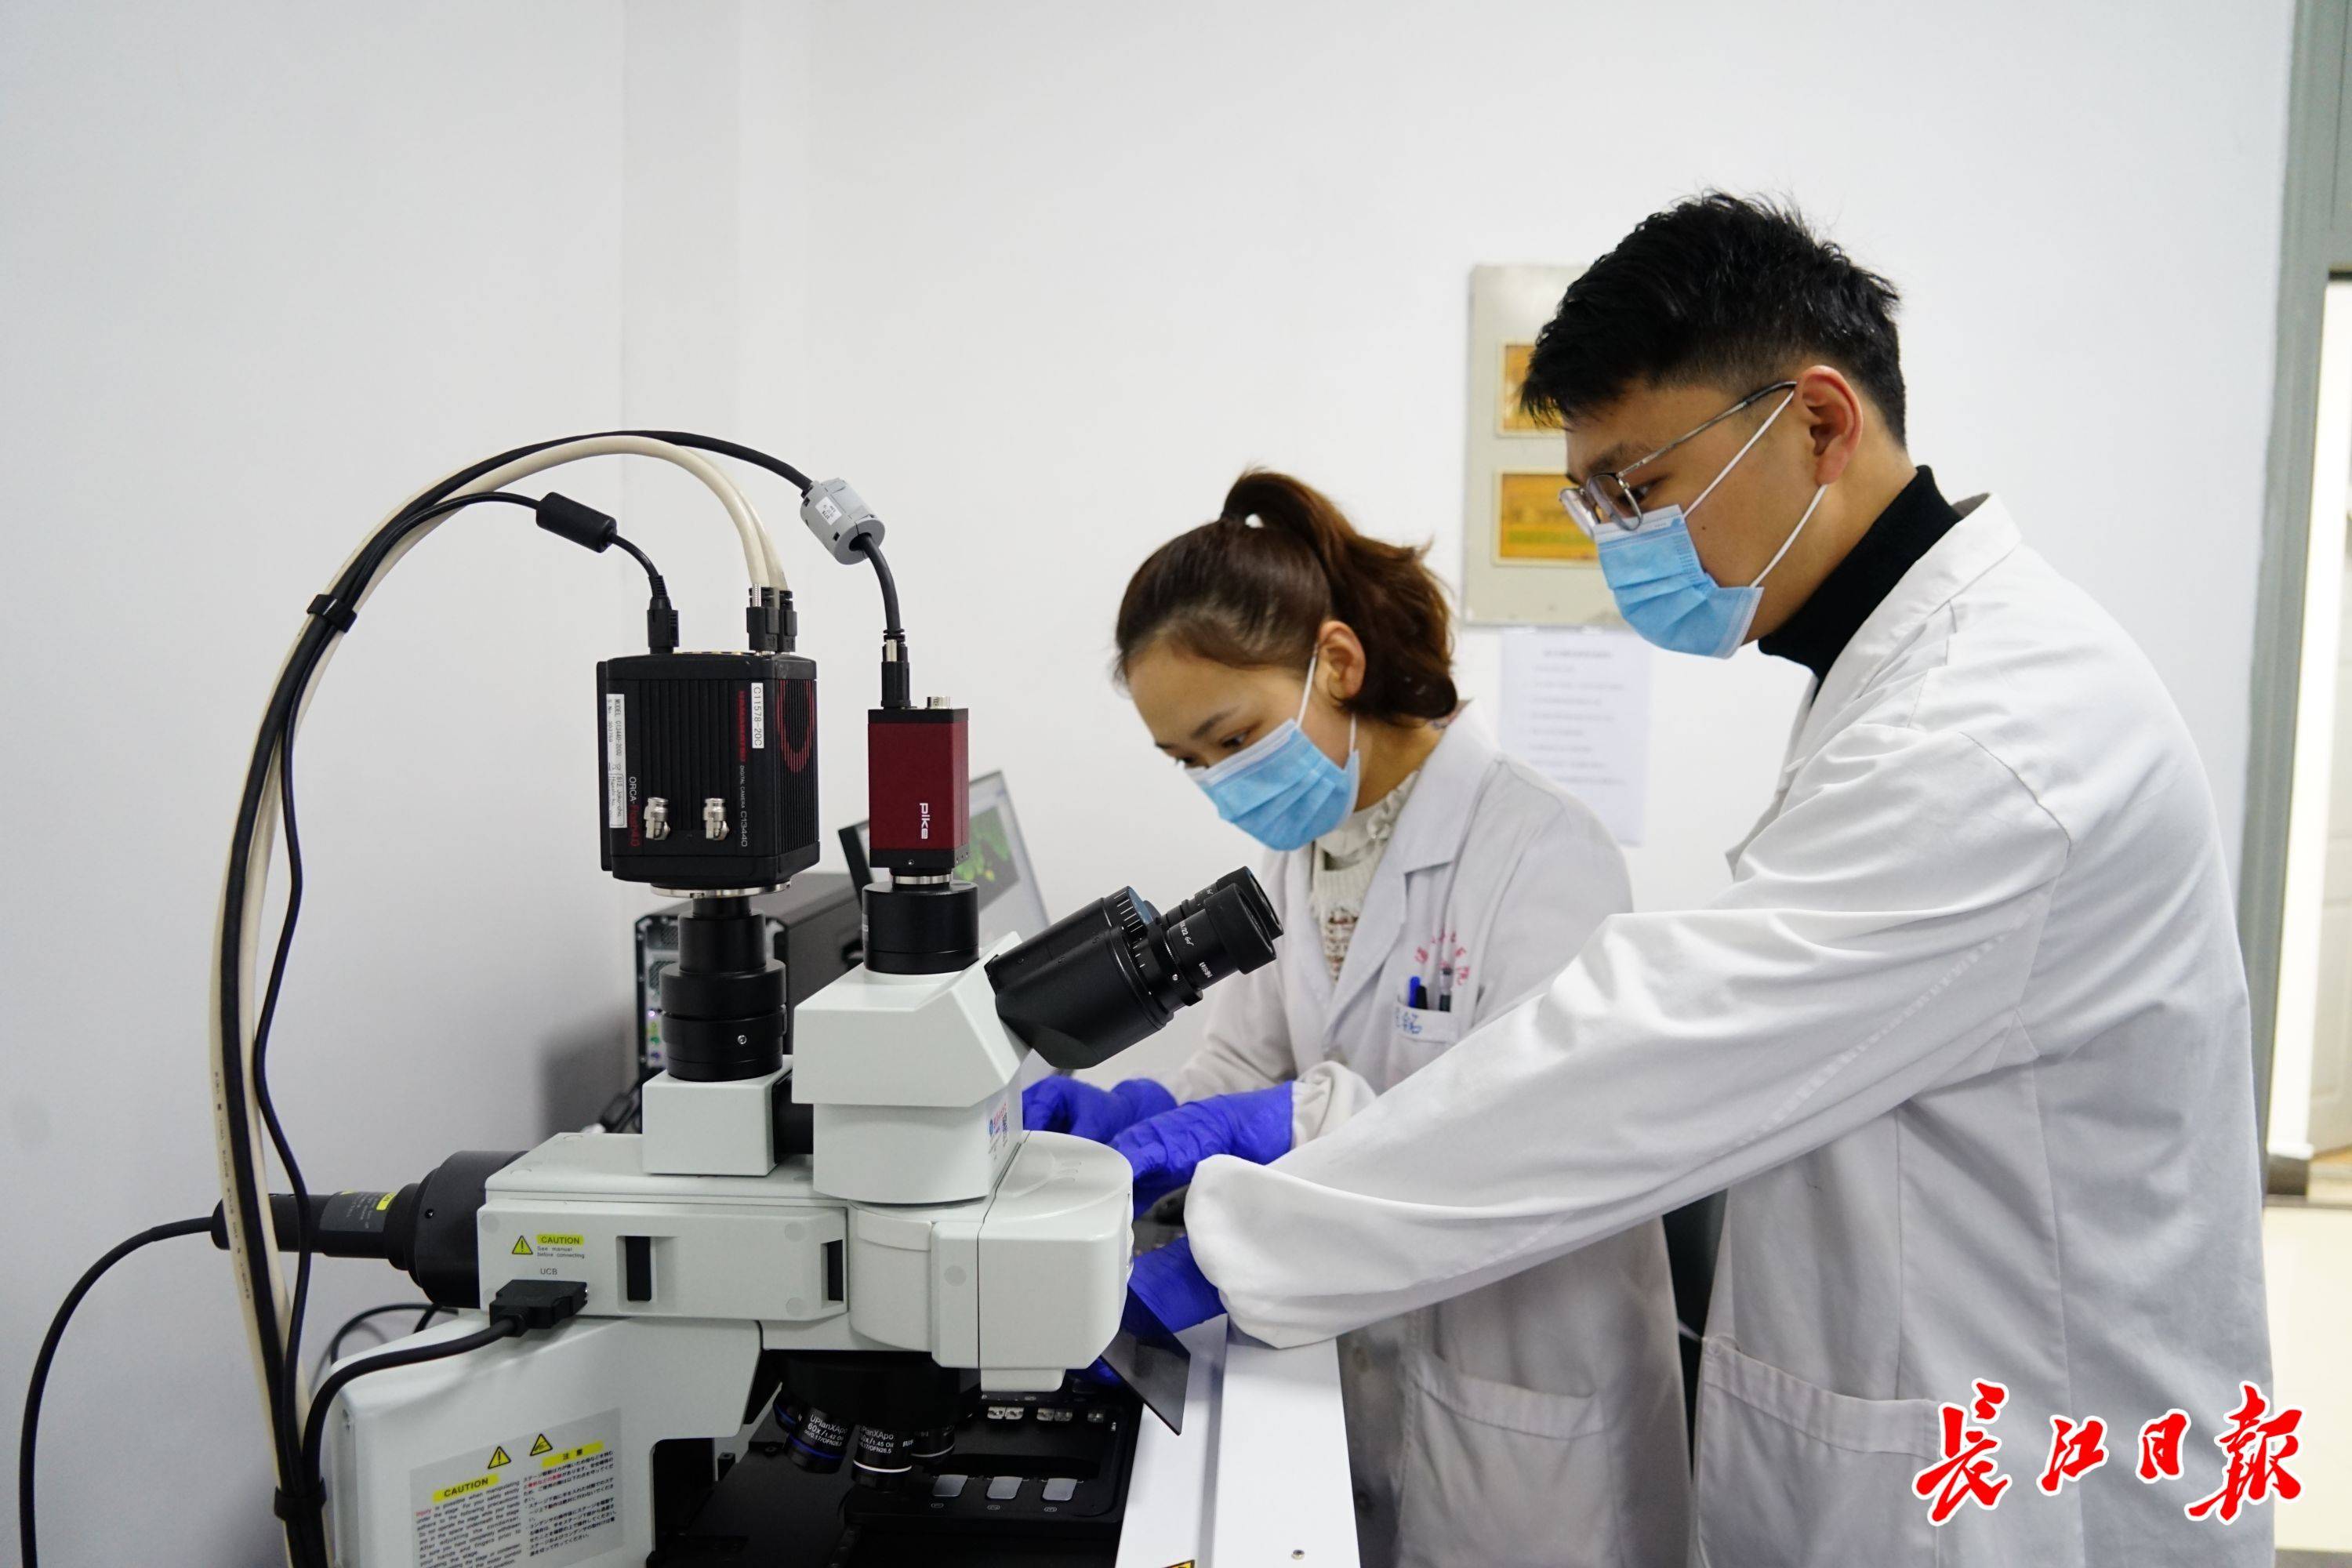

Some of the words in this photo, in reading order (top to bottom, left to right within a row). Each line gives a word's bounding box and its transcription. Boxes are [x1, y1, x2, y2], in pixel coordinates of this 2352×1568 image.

[753, 686, 762, 747] C11578-20C
[919, 803, 931, 840] pike
[444, 1477, 488, 1497] CAUTION
